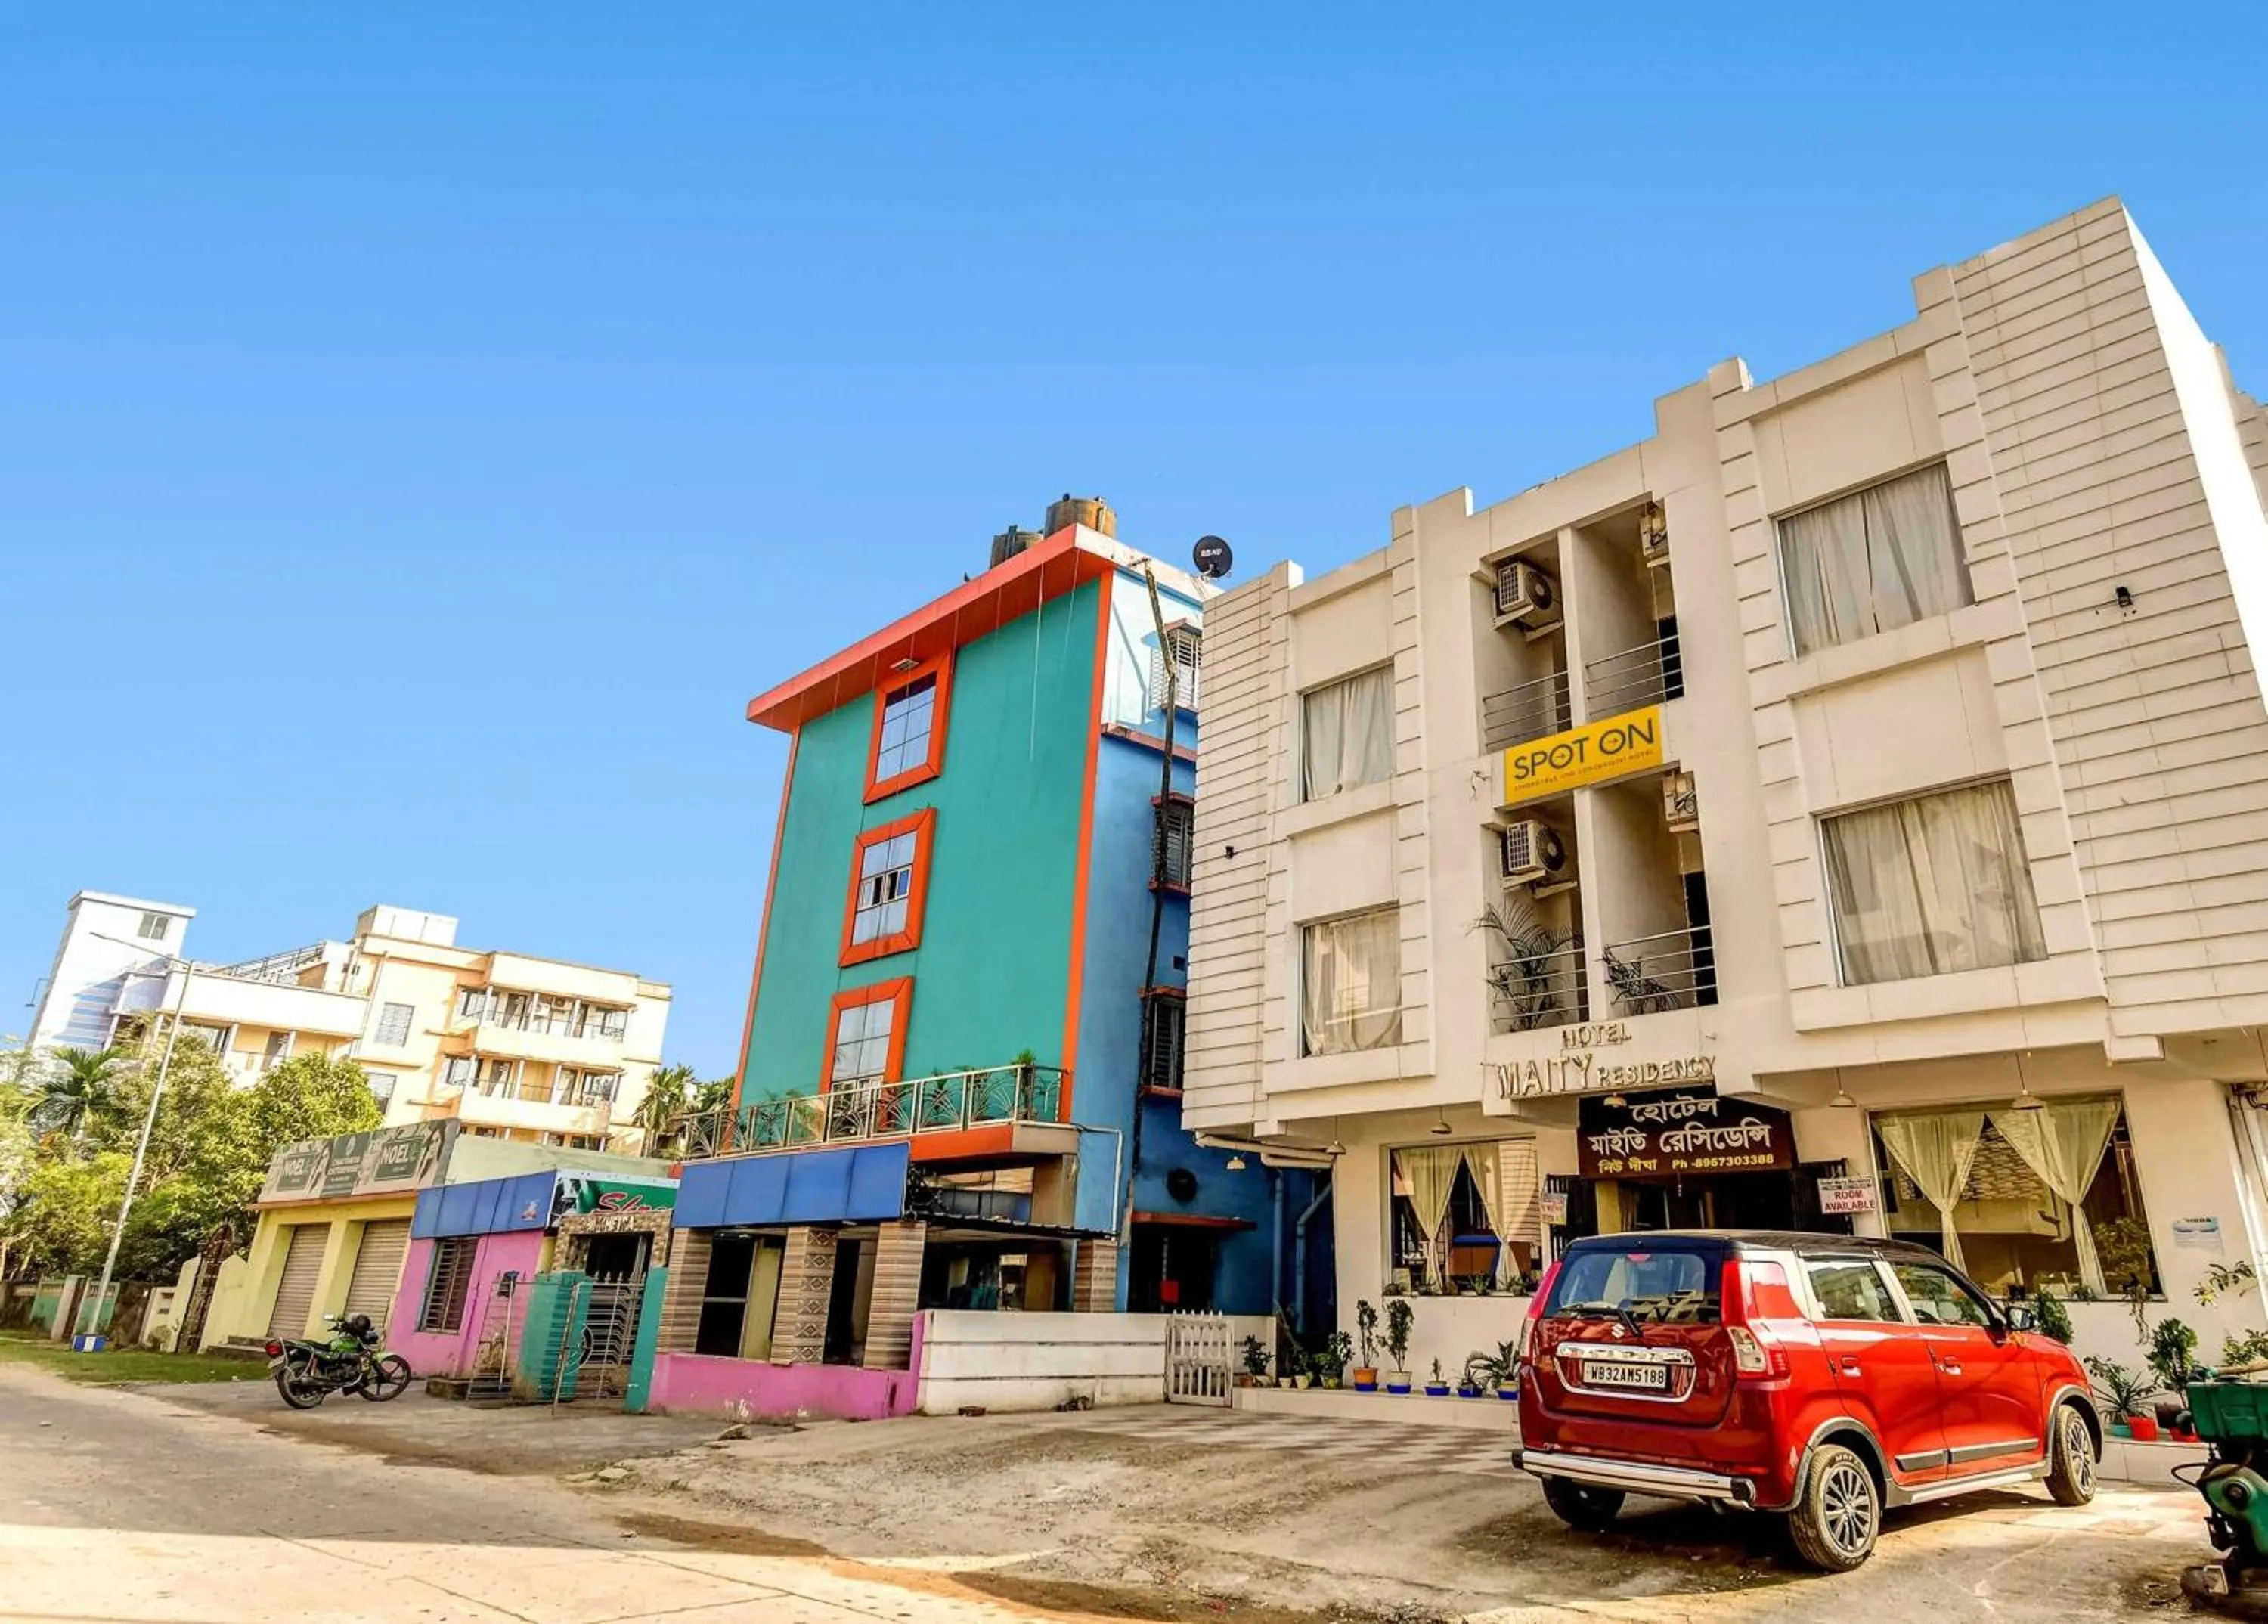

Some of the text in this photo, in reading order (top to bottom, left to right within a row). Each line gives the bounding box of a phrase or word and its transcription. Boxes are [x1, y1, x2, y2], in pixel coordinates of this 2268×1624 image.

[1514, 717, 1653, 779] SPOT ON
[1563, 1022, 1632, 1048] HOTEL
[1497, 1053, 1717, 1099] MAITY RESIDENCY
[1628, 1095, 1720, 1123] হোটেল
[1588, 1126, 1647, 1157] মাইতি
[1672, 1159, 1688, 1170] Ph
[1824, 1199, 1876, 1210] AVAILABLE
[1834, 1189, 1863, 1200] ROOM
